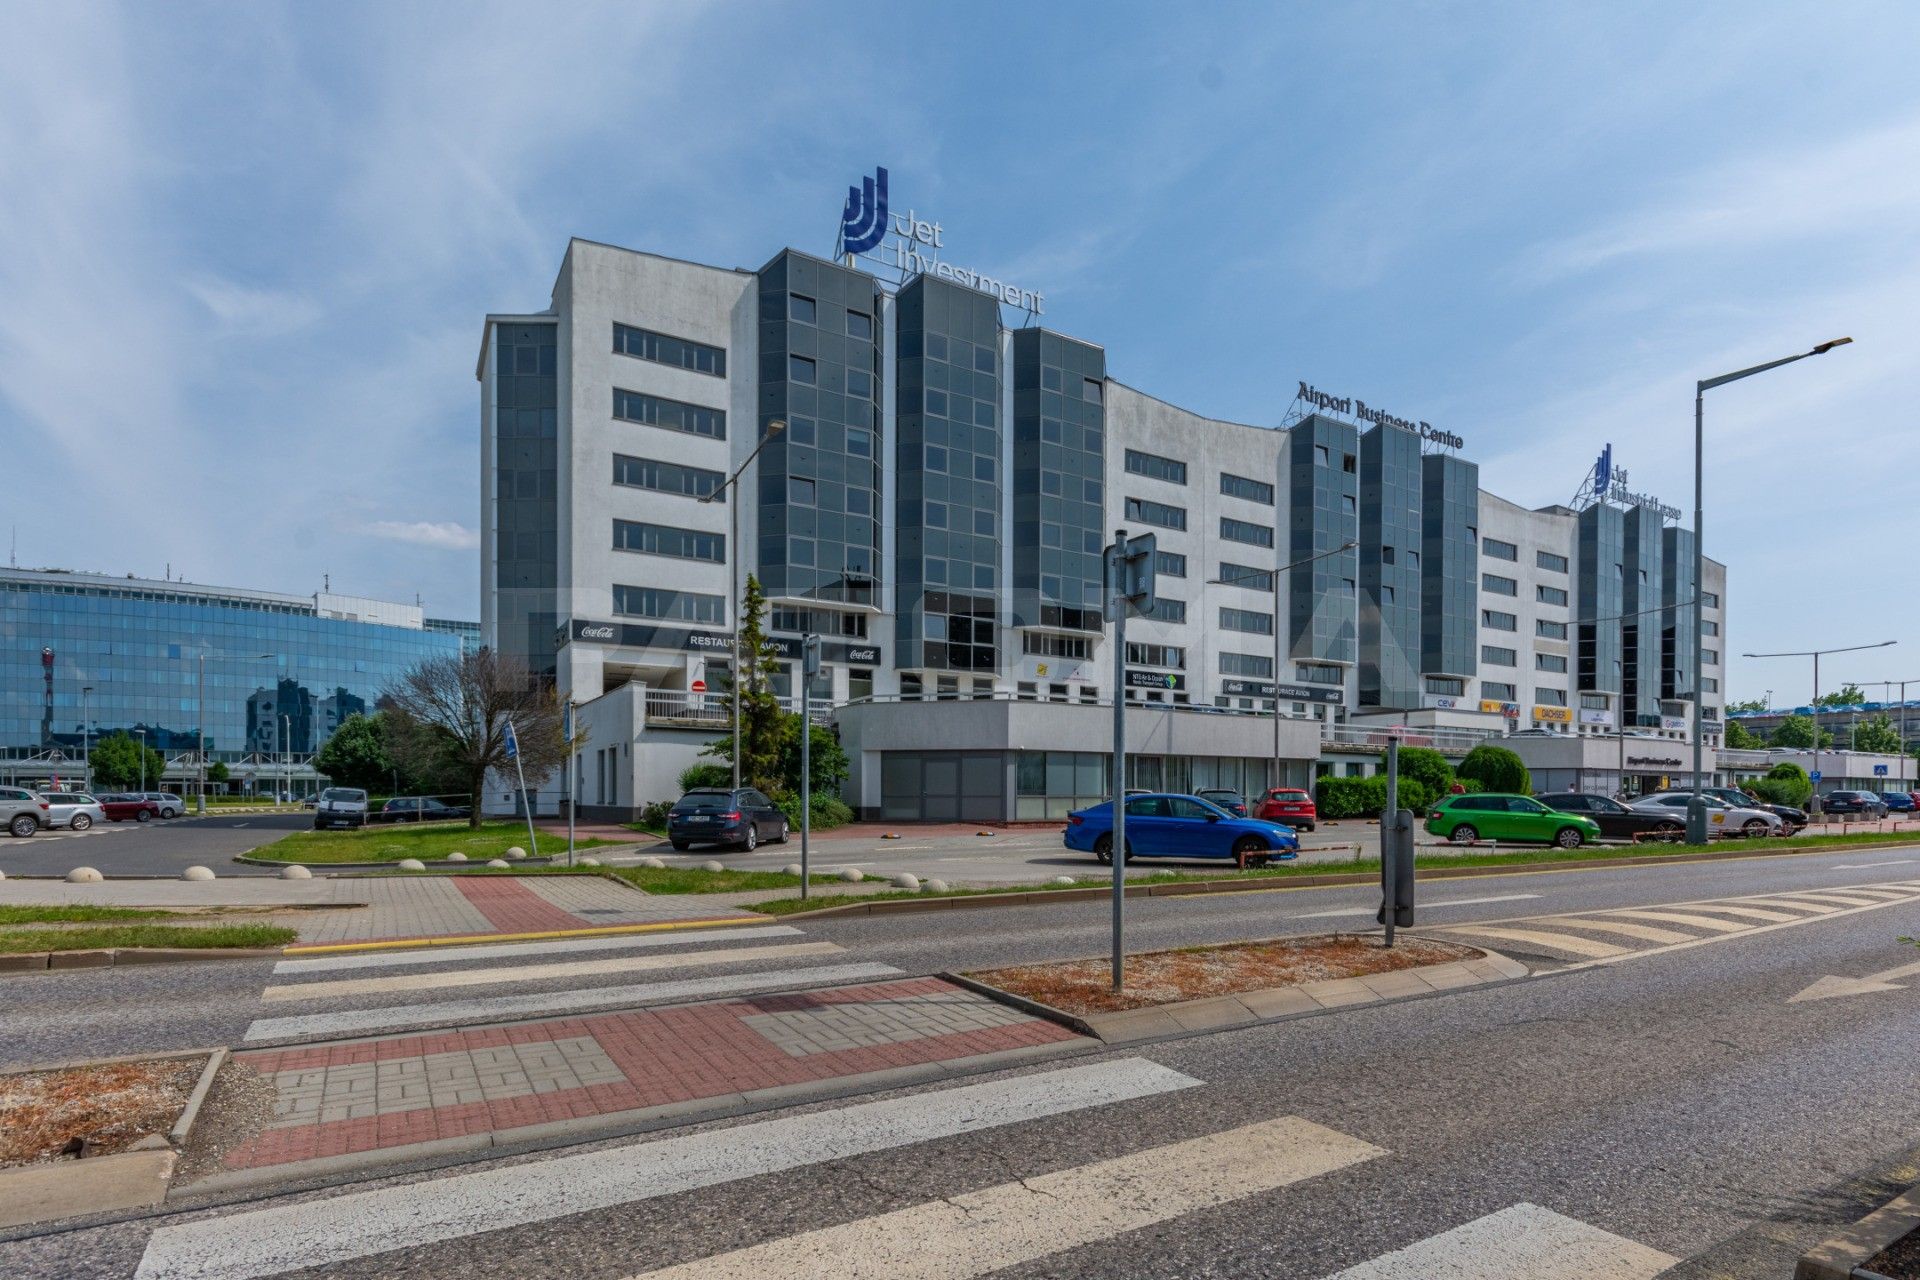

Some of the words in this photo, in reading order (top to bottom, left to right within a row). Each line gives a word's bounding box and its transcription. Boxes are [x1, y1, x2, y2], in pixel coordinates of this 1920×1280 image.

[895, 209, 944, 248] Jet
[896, 239, 1045, 315] Investment
[1297, 381, 1351, 415] Airport
[1355, 399, 1416, 433] Business
[1419, 421, 1464, 450] Centre
[759, 642, 788, 653] AVION
